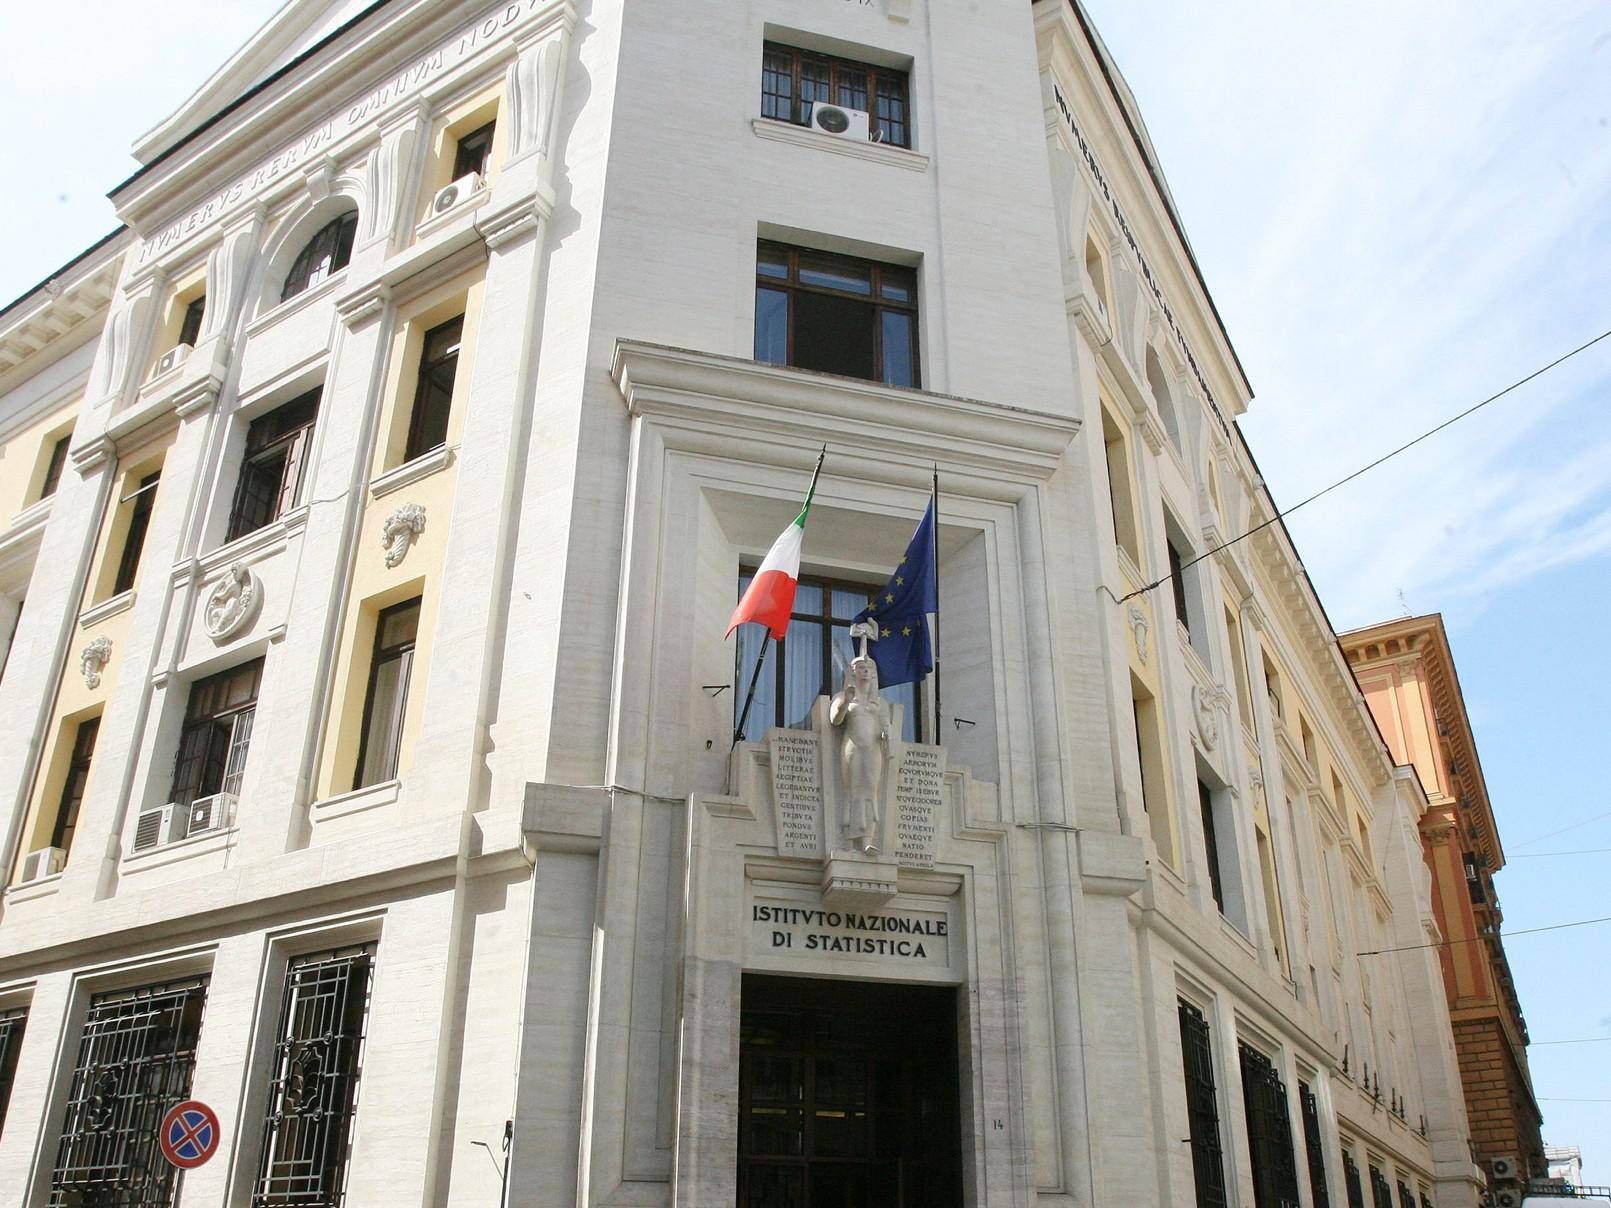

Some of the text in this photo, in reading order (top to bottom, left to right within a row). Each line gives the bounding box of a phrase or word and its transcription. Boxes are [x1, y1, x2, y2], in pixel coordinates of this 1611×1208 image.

[139, 182, 244, 263] NVMERVS
[251, 122, 334, 191] RERVM
[347, 50, 444, 125] OMNIVM
[753, 904, 948, 937] ISTITVTO NAZIONALE
[772, 931, 927, 959] DI STATISTICA
[993, 1119, 1004, 1131] 14
